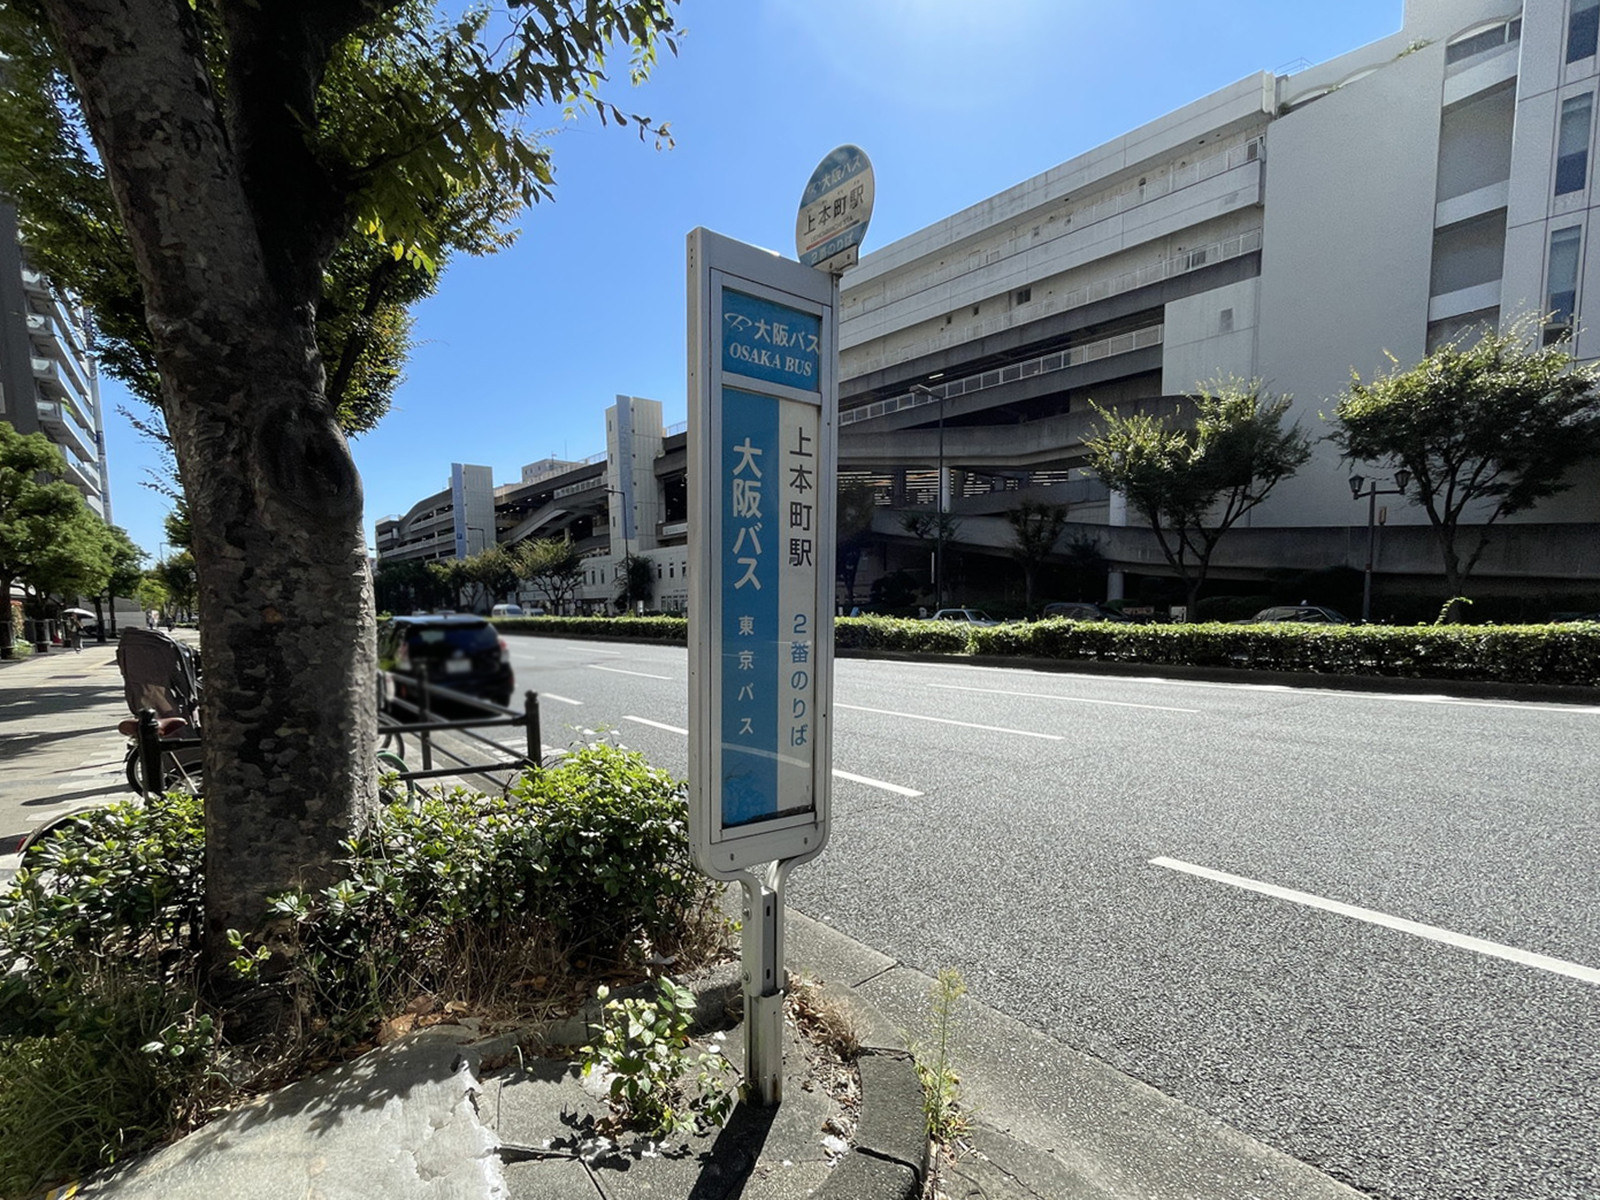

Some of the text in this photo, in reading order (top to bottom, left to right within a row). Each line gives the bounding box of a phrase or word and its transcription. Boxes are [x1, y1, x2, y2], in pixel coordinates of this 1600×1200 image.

[803, 184, 865, 236] 上本町駅
[730, 342, 812, 377] OSAKA BUS
[754, 319, 820, 354] 大阪バス
[732, 437, 763, 590] 大阪バス
[789, 427, 813, 746] 上本町駅 2番のりば
[738, 615, 755, 735] 東京バス
